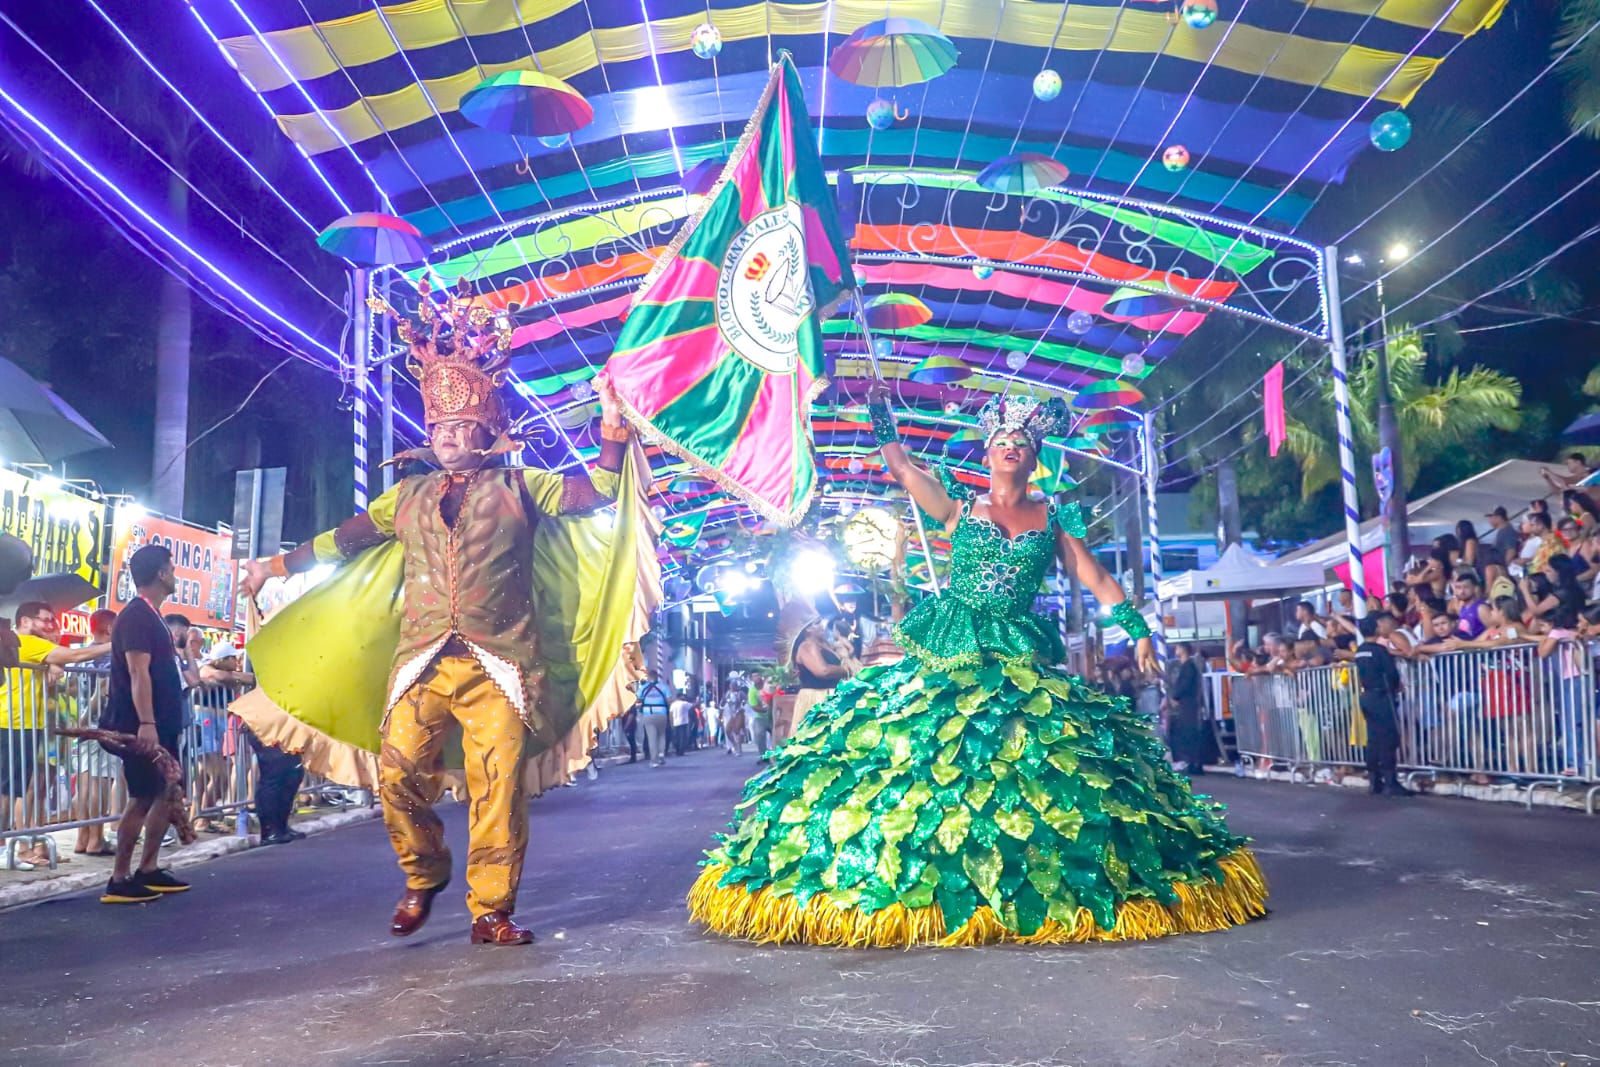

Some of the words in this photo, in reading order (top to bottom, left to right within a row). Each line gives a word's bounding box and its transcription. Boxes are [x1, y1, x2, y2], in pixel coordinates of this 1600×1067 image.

[719, 288, 743, 341] BLOCO
[132, 525, 146, 538] GIN
[164, 577, 201, 608] EER
